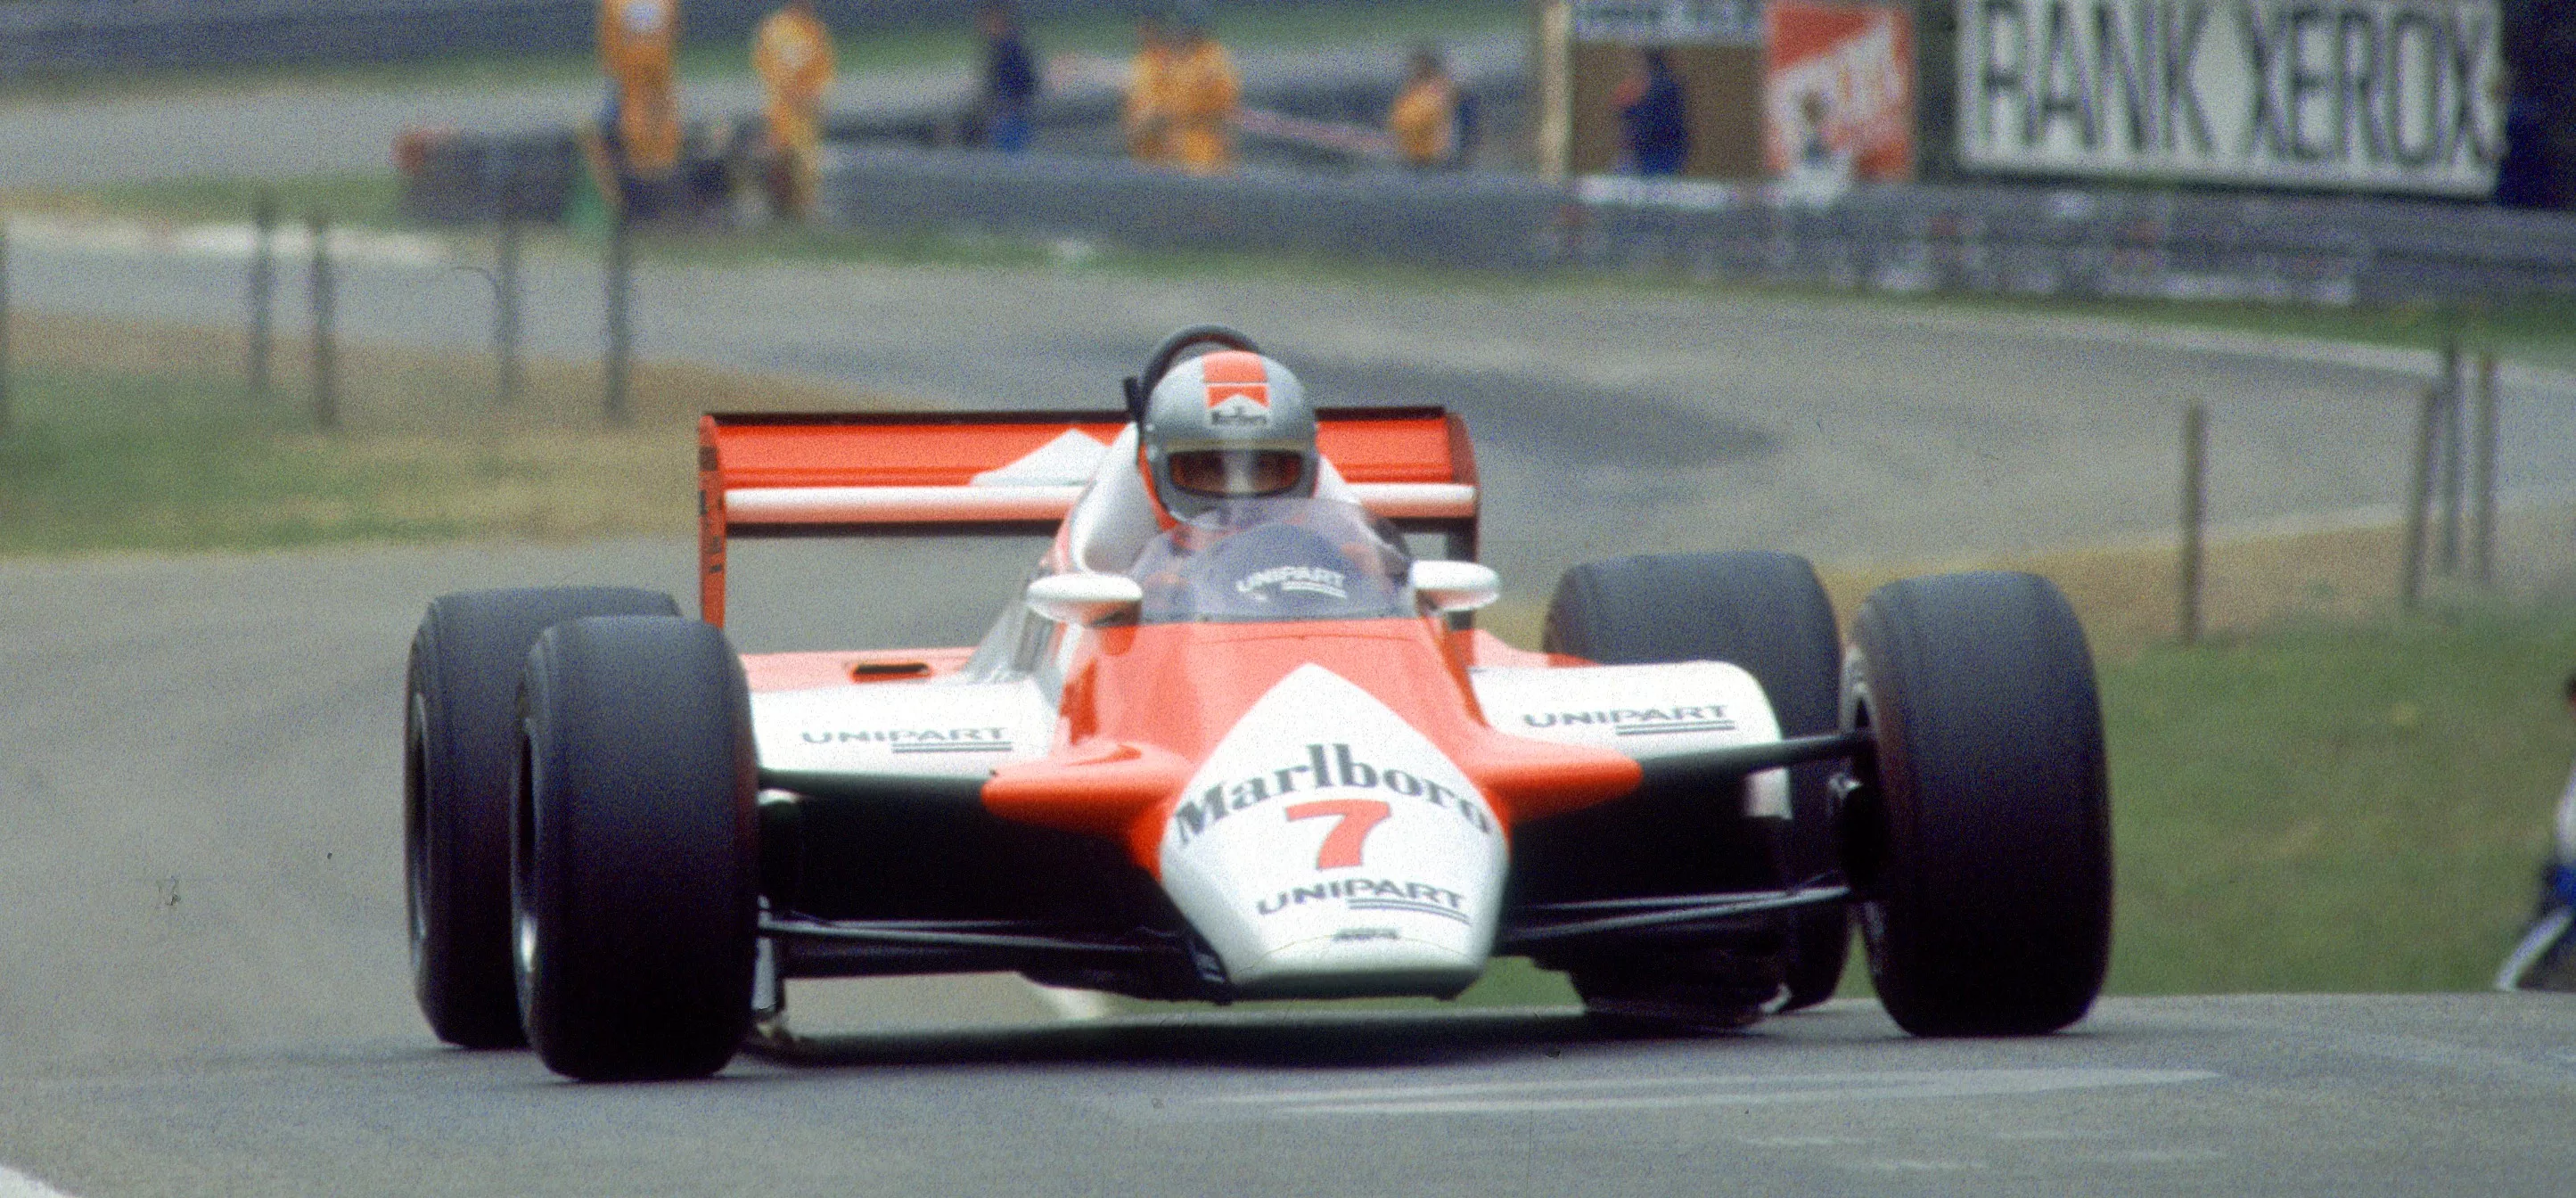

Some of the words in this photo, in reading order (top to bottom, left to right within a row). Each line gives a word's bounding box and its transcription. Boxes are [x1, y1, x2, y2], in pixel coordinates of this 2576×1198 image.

[1973, 0, 2219, 153] RANK
[2237, 0, 2501, 169] XEROX
[1235, 565, 1345, 593] UNIPART
[1522, 704, 1727, 728] UNIPART
[800, 726, 1007, 744] UNIPART
[1173, 743, 1491, 846] Marlboro
[1284, 799, 1392, 871] 7
[1256, 878, 1467, 915] UNIPART
